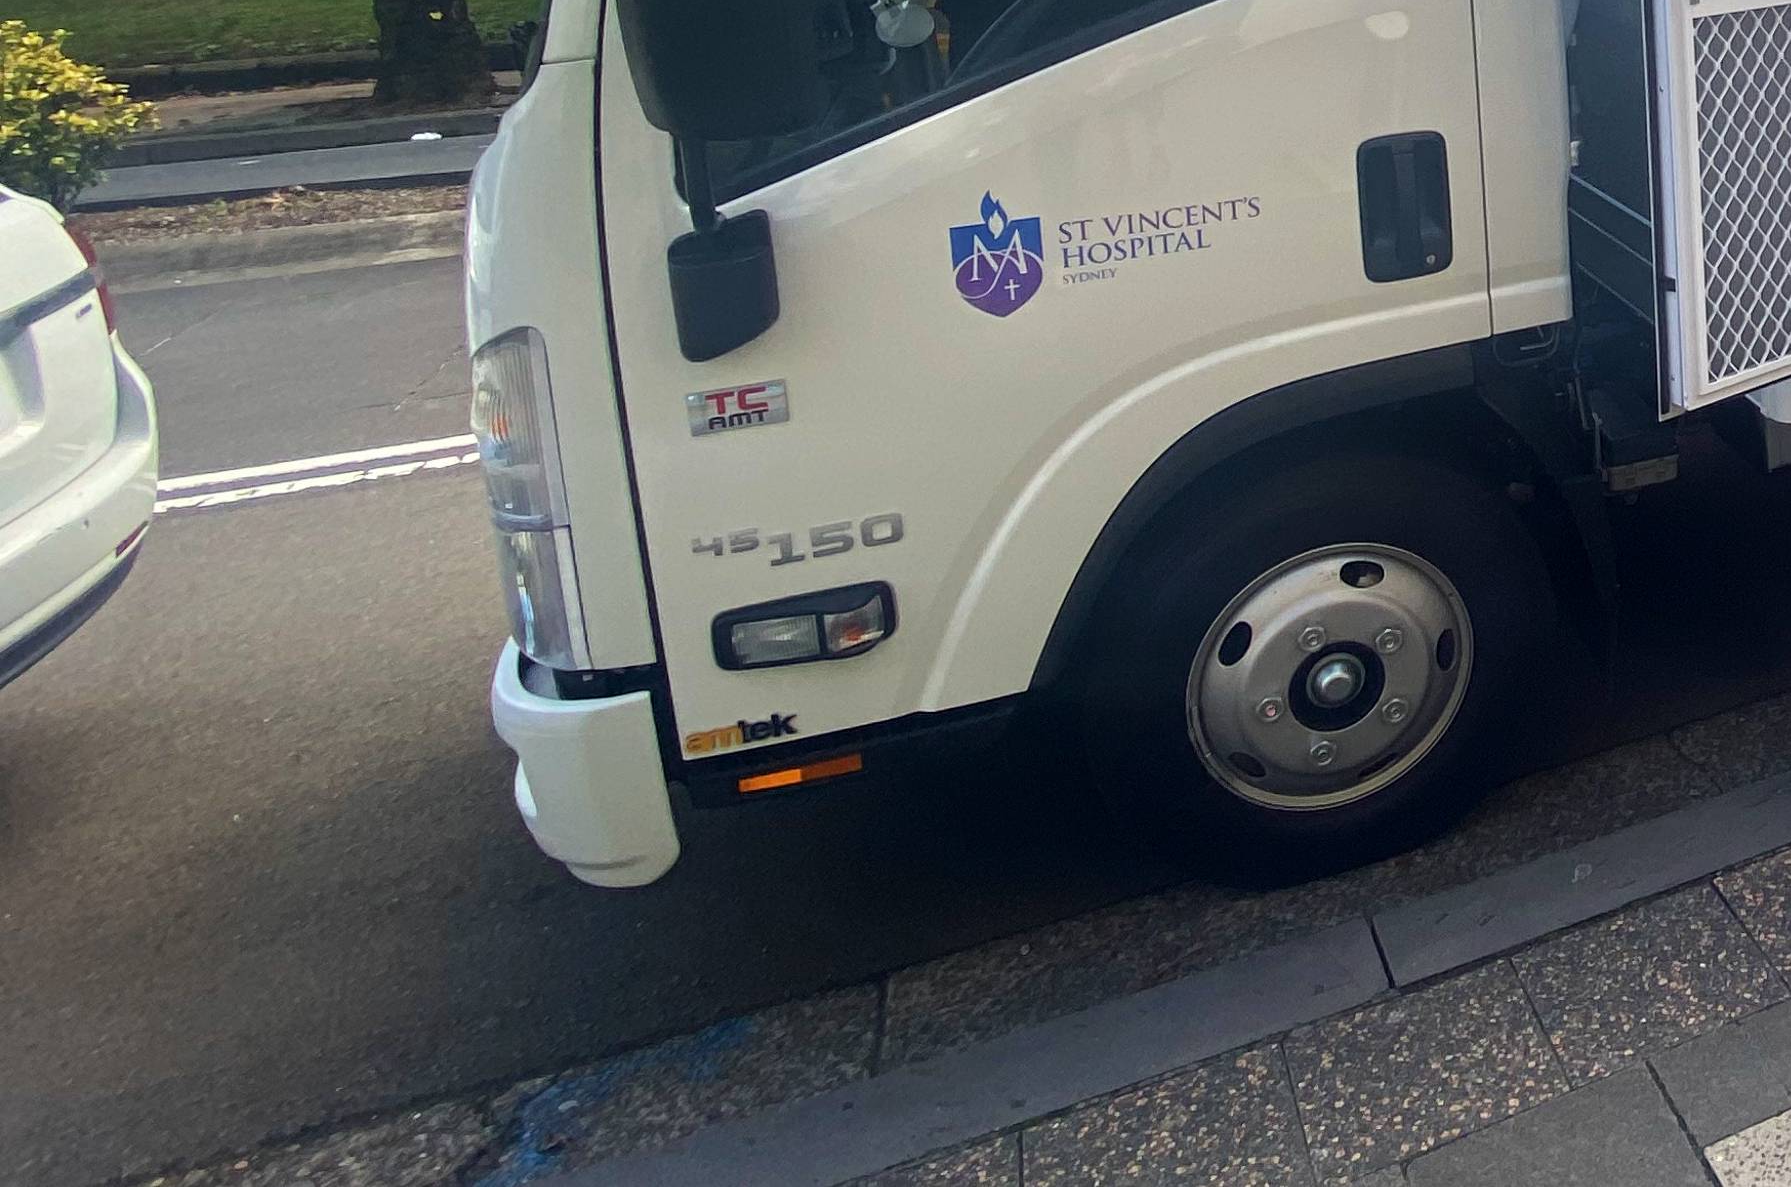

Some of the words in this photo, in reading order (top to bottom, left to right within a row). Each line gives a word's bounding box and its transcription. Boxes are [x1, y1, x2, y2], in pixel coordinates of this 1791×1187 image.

[1058, 219, 1094, 244] ST
[1101, 196, 1261, 237] VINCENT'S
[1060, 228, 1212, 268] HOSPITAL
[1062, 267, 1118, 285] SYDNEY
[705, 386, 769, 416] TC
[708, 409, 769, 430] AMT
[690, 527, 760, 557] 45
[766, 512, 905, 567] 150
